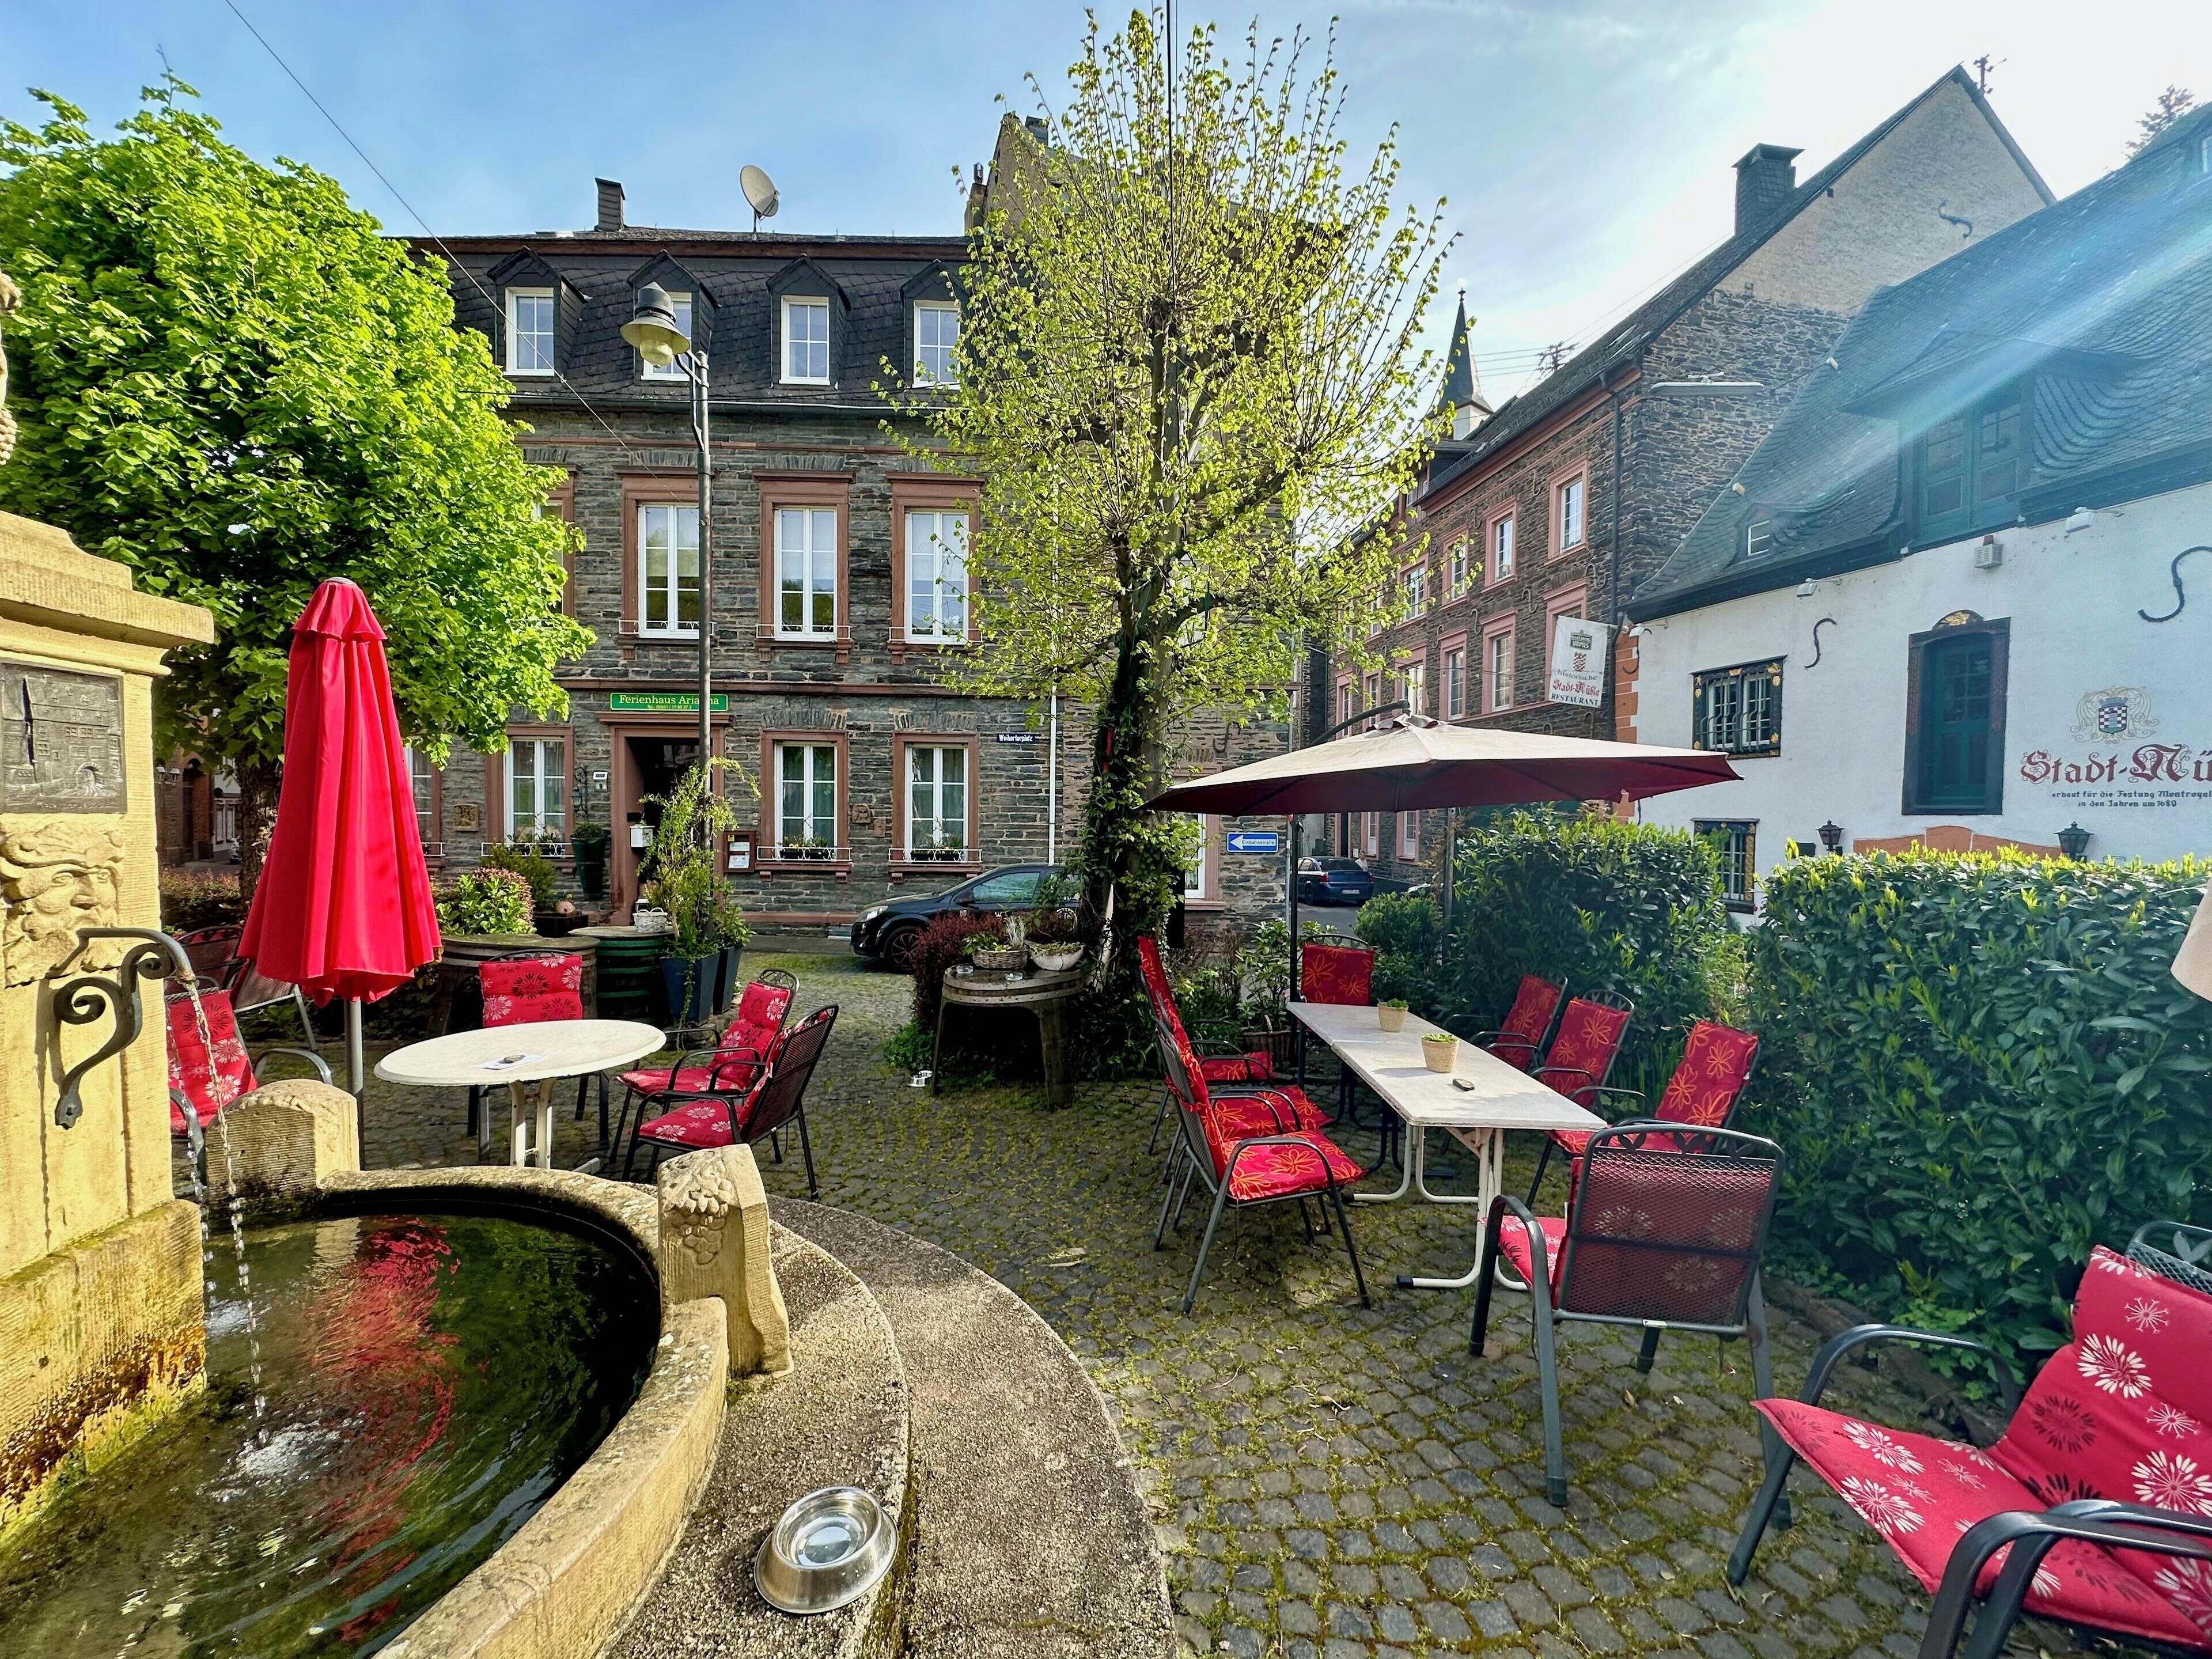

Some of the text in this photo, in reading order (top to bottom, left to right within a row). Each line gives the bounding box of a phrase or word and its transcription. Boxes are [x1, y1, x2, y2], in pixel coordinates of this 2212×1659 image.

[1558, 669, 1598, 680] historische
[1552, 679, 1600, 696] Stadt-Mühle
[619, 695, 719, 704] Ferienhaus Ariana
[1551, 693, 1599, 706] RESTAURANT
[2116, 790, 2154, 799] Festung
